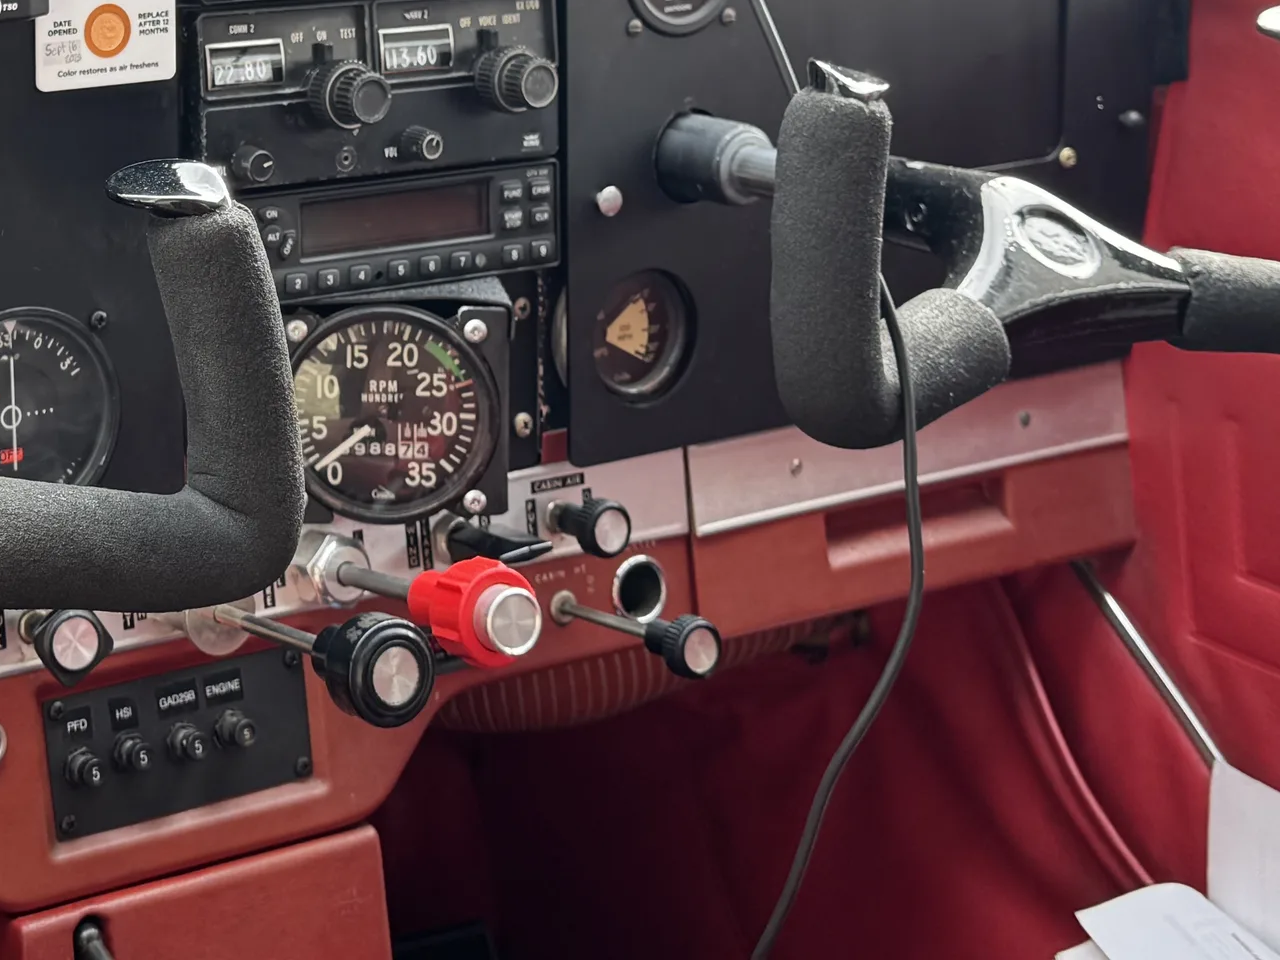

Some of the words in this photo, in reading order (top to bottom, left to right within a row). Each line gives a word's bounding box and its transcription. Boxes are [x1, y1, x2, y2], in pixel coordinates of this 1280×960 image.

[3, 3, 18, 12] TSO
[138, 10, 169, 20] REPLACE
[478, 15, 497, 26] VOICE
[502, 13, 521, 25] IDENT
[53, 20, 72, 28] DATE
[163, 18, 169, 26] 12
[459, 17, 472, 28] OFF
[48, 28, 78, 37] OPENED
[139, 27, 169, 36] MONTHS
[339, 28, 356, 39] TEST
[291, 32, 304, 44] OFF
[385, 45, 438, 70] 113.60
[57, 69, 77, 78] Color
[79, 66, 107, 76] restores
[129, 61, 159, 70] freshens
[266, 210, 278, 218] ON
[267, 232, 280, 241] ALT
[459, 256, 466, 267] 7
[358, 270, 365, 280] 4
[397, 264, 405, 276] 5
[295, 278, 301, 289] 2
[326, 275, 334, 285] 3
[346, 344, 369, 369] 15
[386, 343, 419, 368] 20
[316, 375, 340, 399] 10
[369, 380, 398, 392] RPM
[415, 372, 448, 397] 25
[311, 416, 328, 440] 5
[427, 411, 458, 437] 30
[326, 461, 343, 486] 0
[404, 462, 437, 487] 35
[534, 480, 563, 492] CABIN
[564, 475, 581, 486] AIR
[407, 527, 418, 570] WING
[205, 679, 241, 697] ENGINE
[158, 690, 196, 710] GAD29B
[115, 706, 133, 720] HSI
[66, 718, 88, 732] PFD
[243, 728, 250, 739] 5
[194, 740, 203, 754] 5
[139, 751, 148, 764] 5
[92, 767, 101, 781] 5
